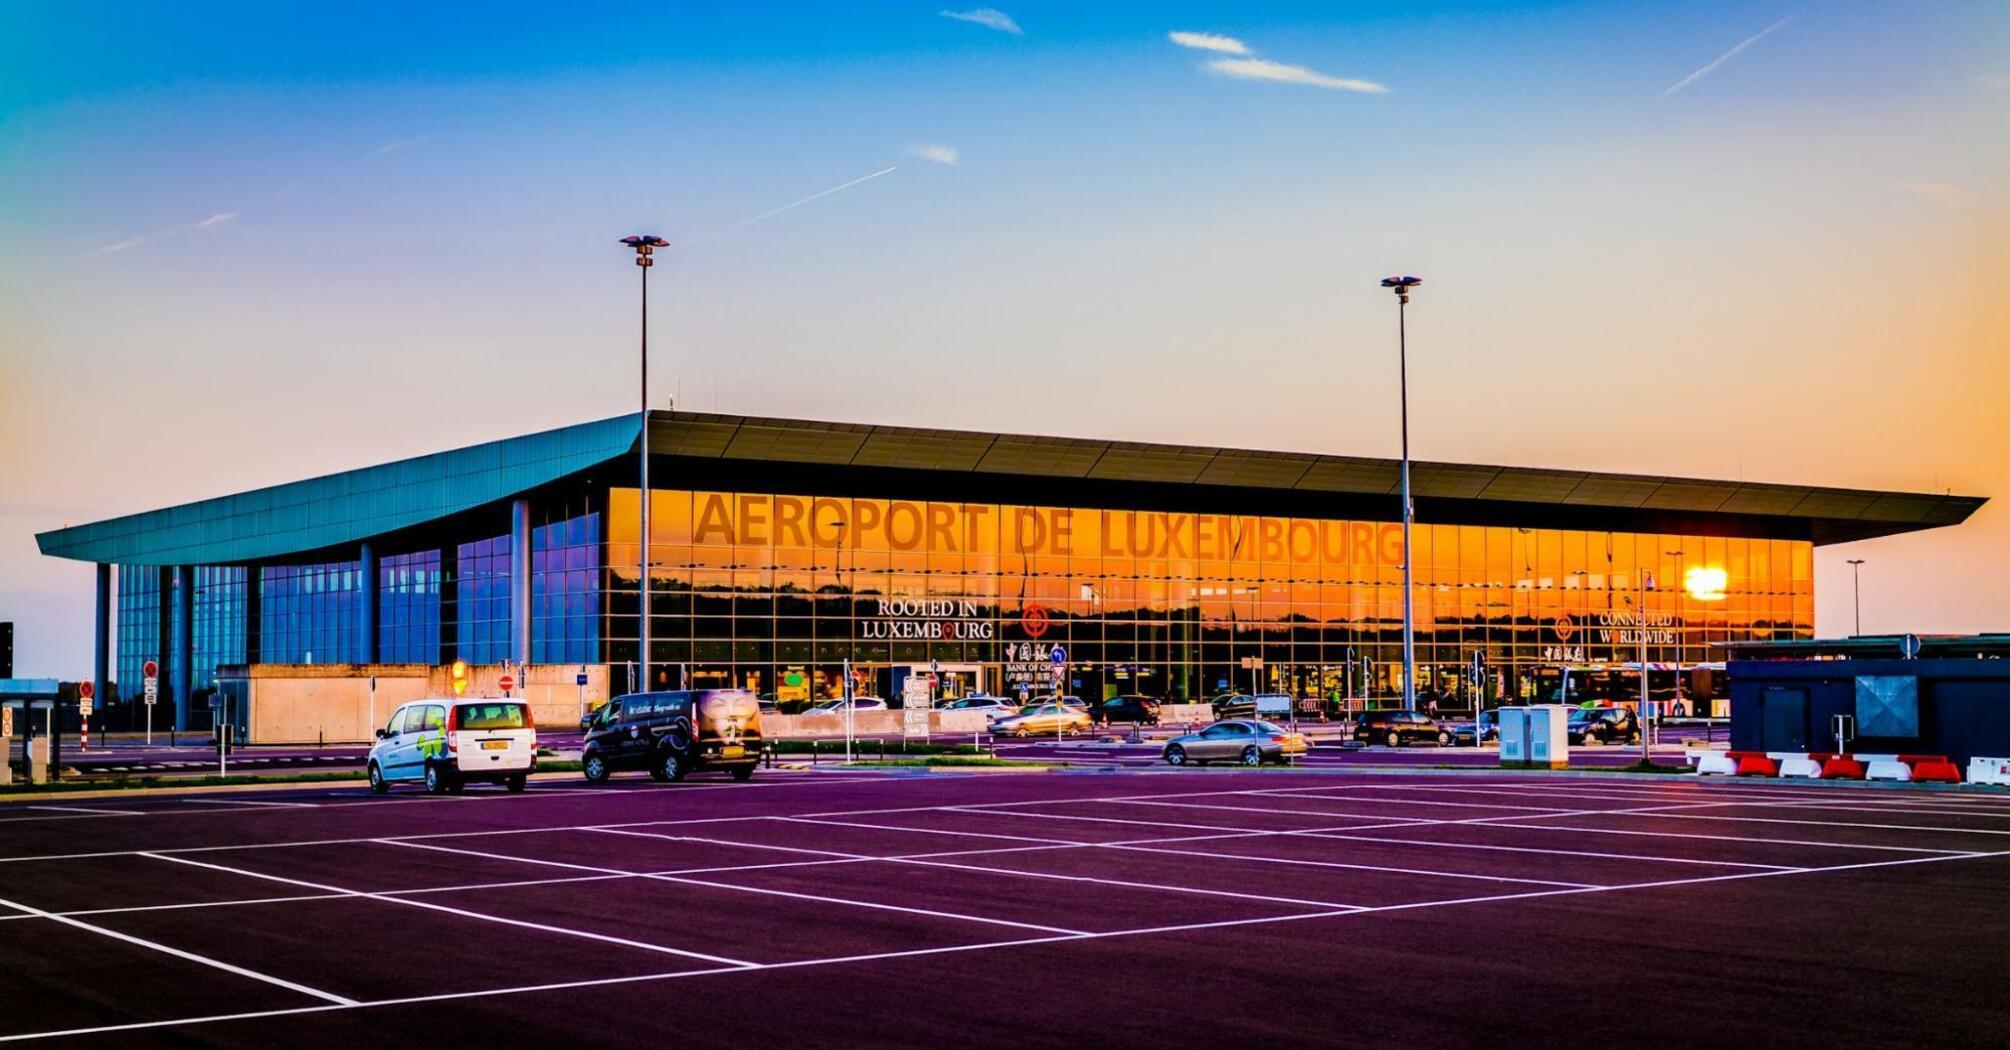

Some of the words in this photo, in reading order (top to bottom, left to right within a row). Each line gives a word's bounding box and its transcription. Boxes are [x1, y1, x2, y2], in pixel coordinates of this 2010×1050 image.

[694, 494, 988, 552] AEROPORT
[1014, 507, 1074, 556] DE
[1102, 511, 1405, 566] LUXEMBOURG
[878, 600, 954, 617] ROOTED
[958, 601, 977, 617] IN
[862, 621, 992, 640] LUXEMBOURG
[1005, 642, 1066, 663] 中国银
[1006, 664, 1027, 672] BANK
